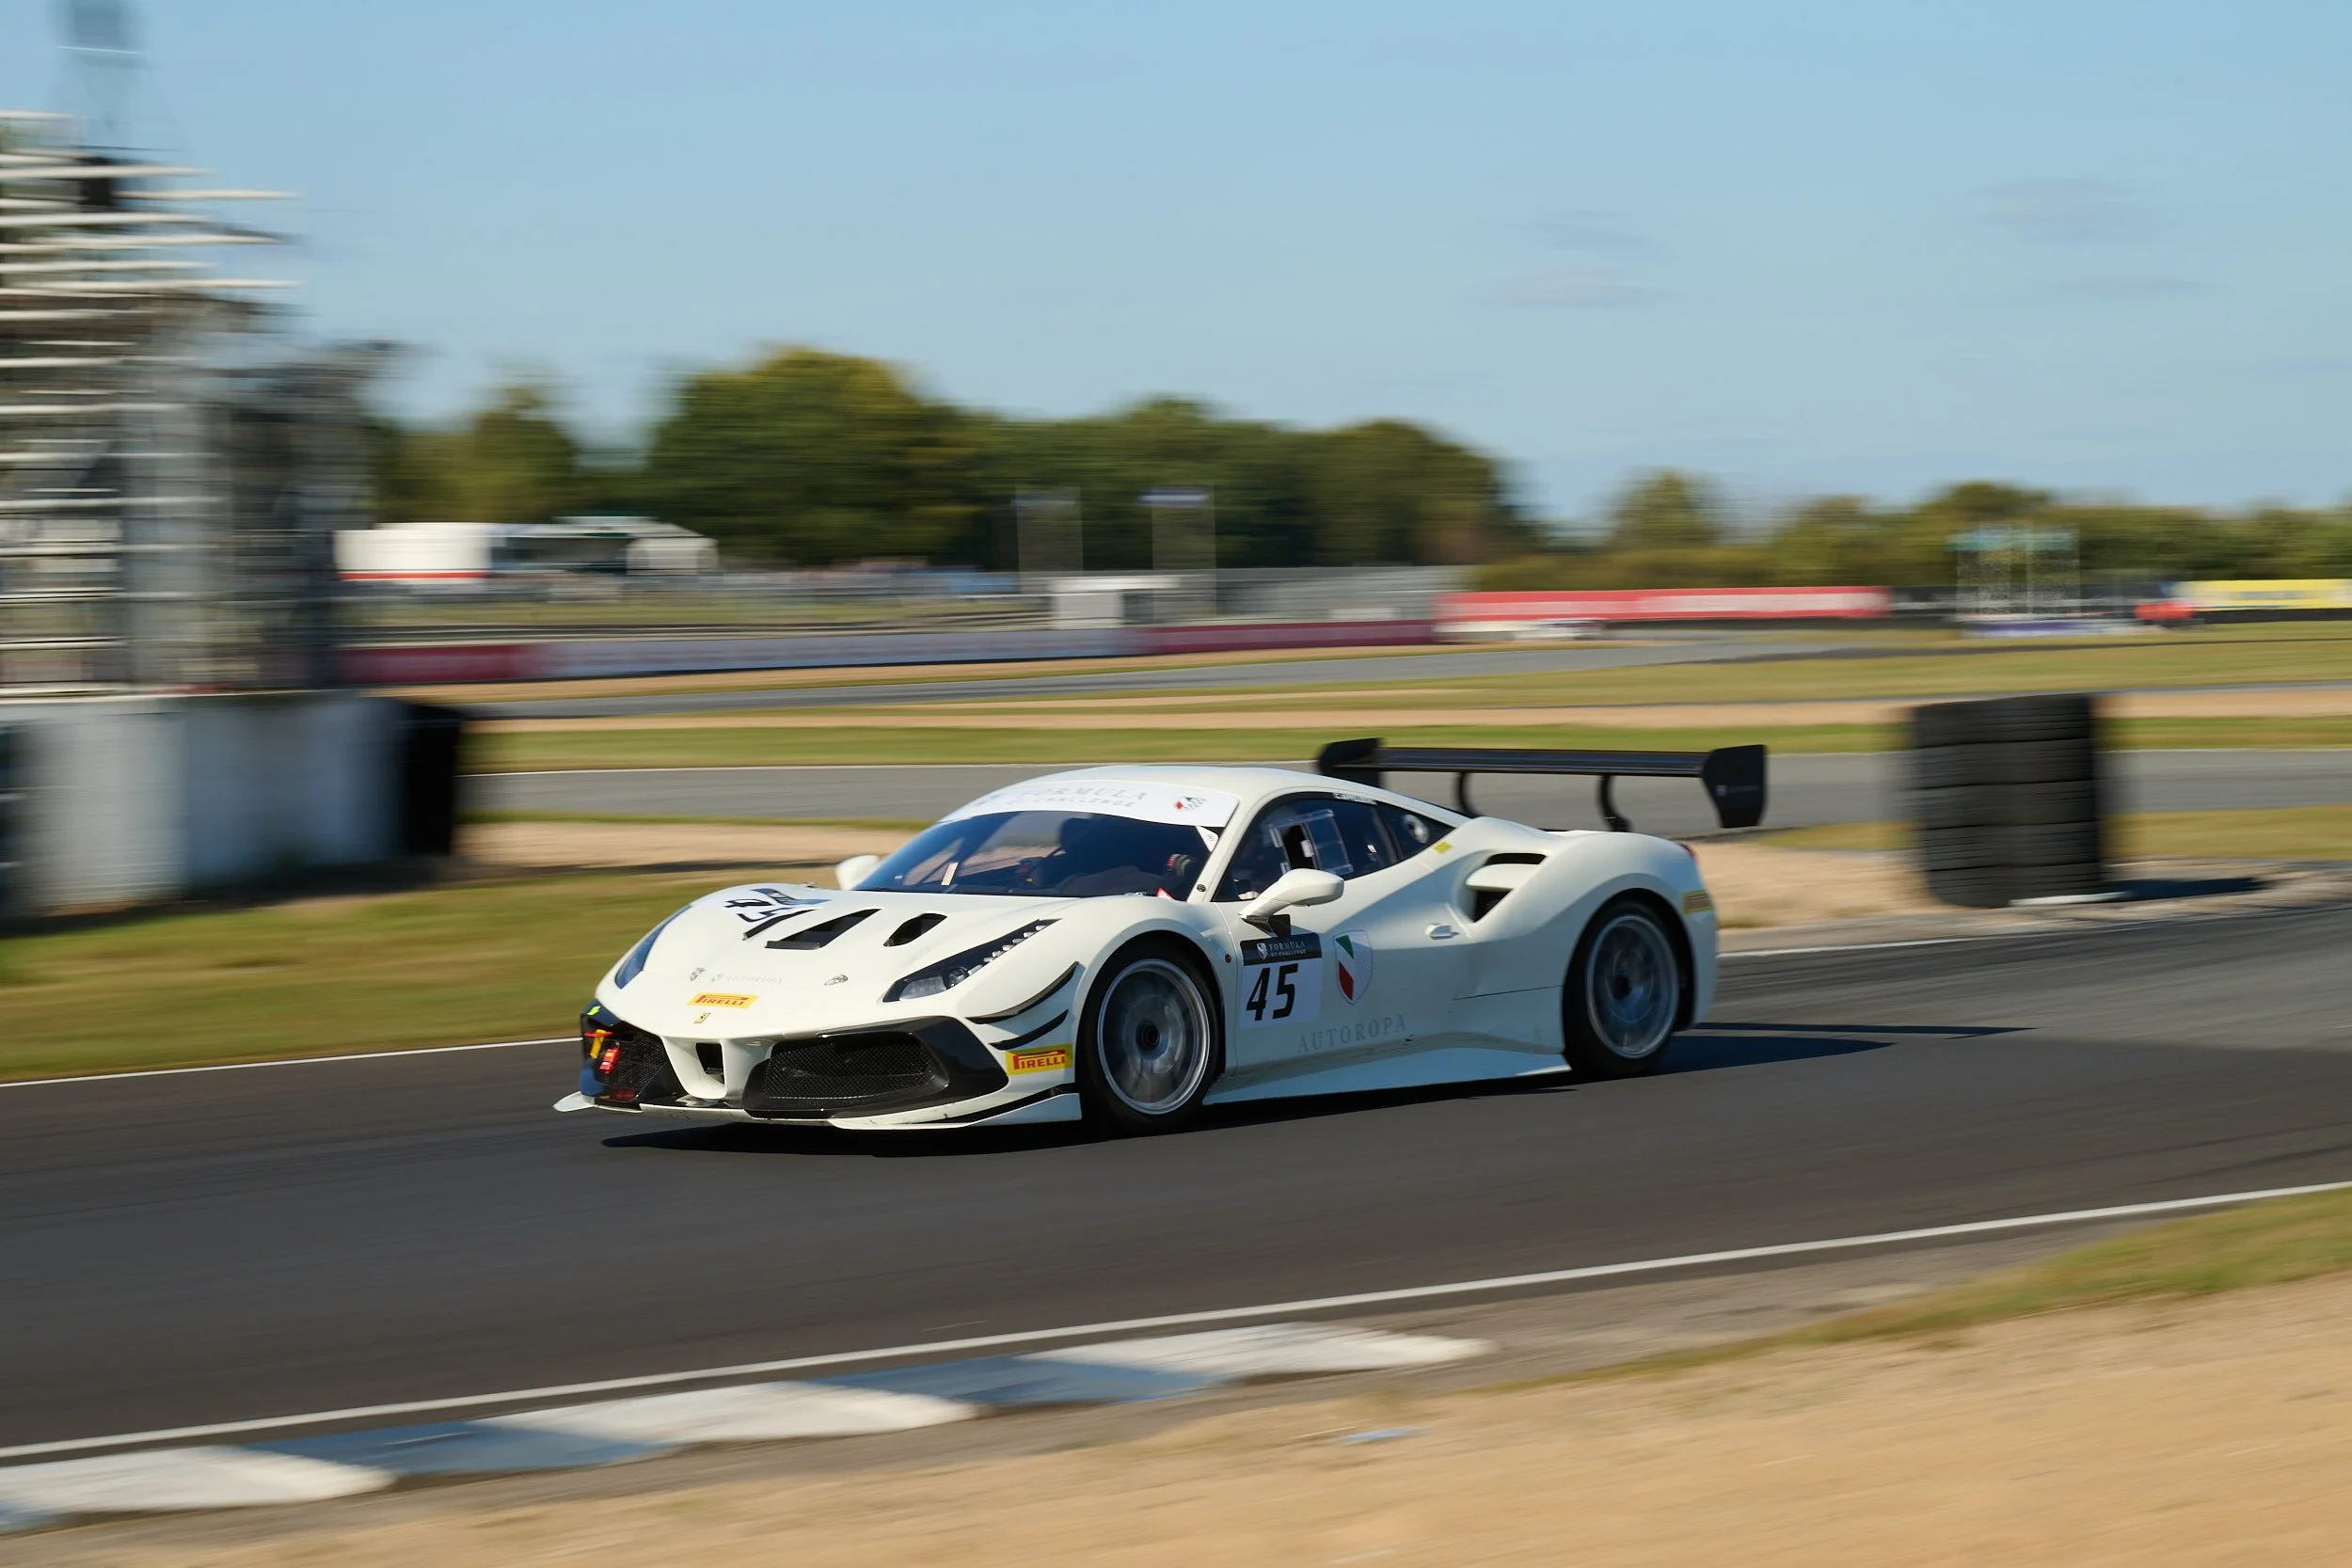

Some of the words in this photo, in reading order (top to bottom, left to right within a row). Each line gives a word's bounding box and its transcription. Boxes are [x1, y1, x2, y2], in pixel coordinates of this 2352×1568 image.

[1268, 940, 1306, 952] FORMULA
[694, 994, 749, 1006] PIRELLI
[1246, 963, 1298, 1021] 45
[1297, 1014, 1406, 1053] AUTOROPA
[1013, 1050, 1066, 1069] PIRELLI
